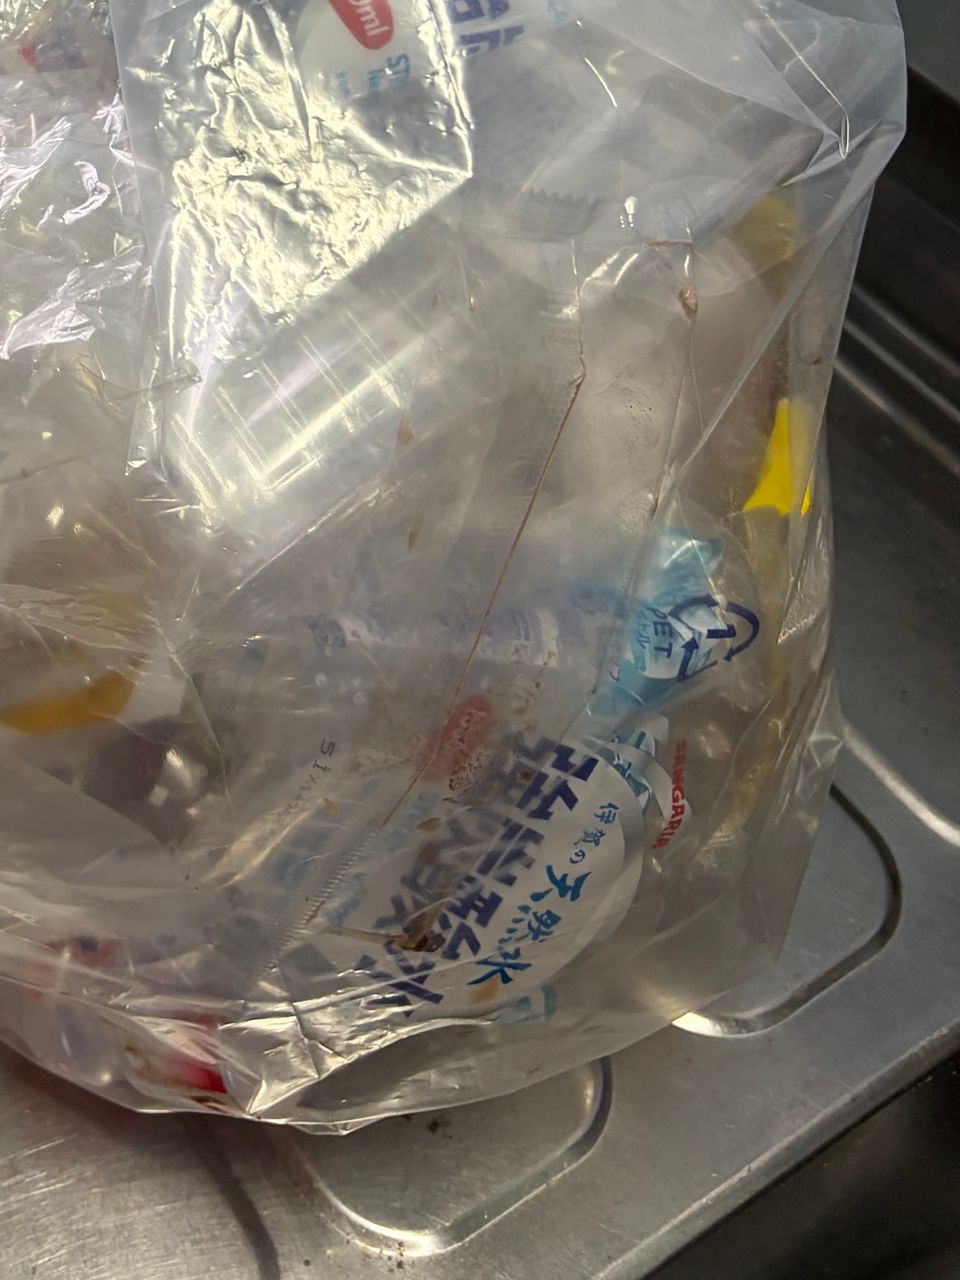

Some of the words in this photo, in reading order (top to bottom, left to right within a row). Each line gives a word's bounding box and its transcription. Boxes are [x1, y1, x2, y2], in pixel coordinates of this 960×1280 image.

[646, 607, 673, 659] PET
[652, 739, 690, 850] SANGARIA
[467, 801, 619, 986] 伊賀の天然水
